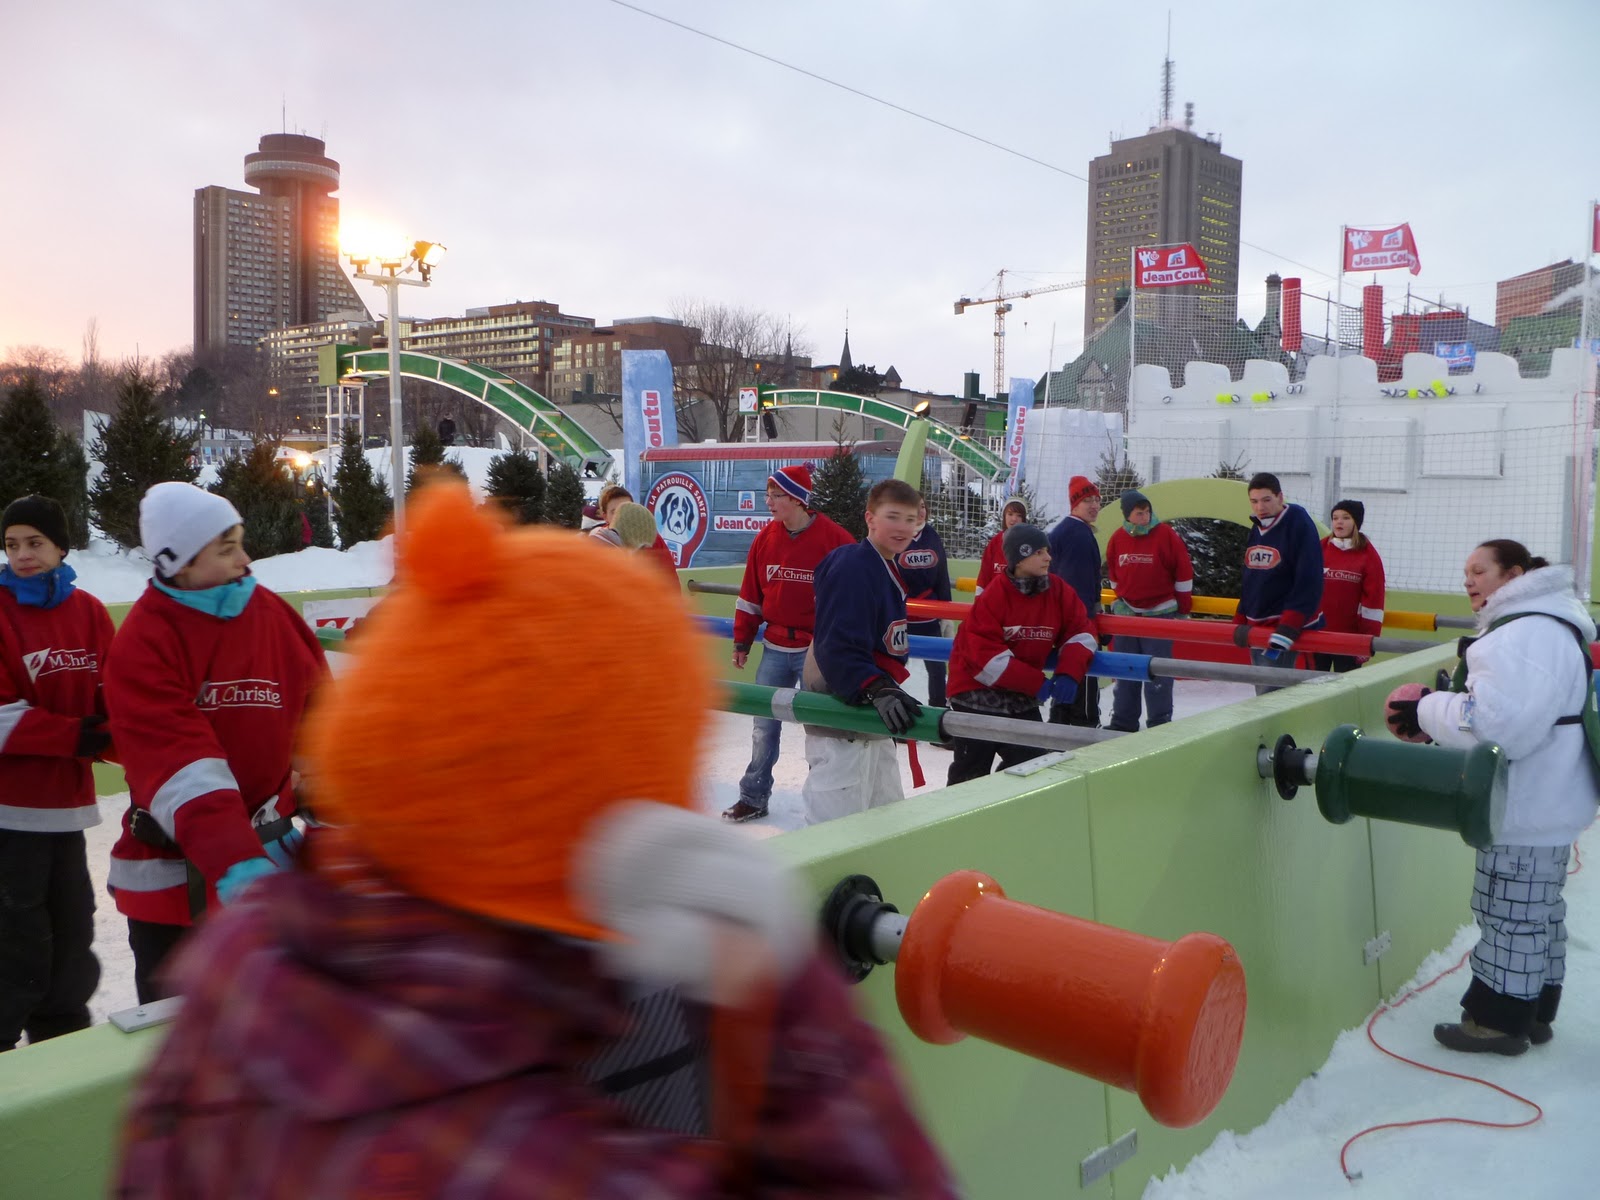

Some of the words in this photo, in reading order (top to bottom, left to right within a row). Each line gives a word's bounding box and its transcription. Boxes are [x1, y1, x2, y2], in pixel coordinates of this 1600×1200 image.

[1354, 254, 1388, 266] Jean
[1143, 272, 1173, 283] Jean
[1174, 269, 1206, 281] Cout
[643, 392, 662, 449] outu
[1010, 407, 1026, 456] Coutu
[649, 495, 657, 506] LA
[656, 477, 694, 493] PATROUILLE
[715, 516, 744, 530] Jean
[744, 517, 771, 530] Cou
[783, 570, 815, 582] Christi
